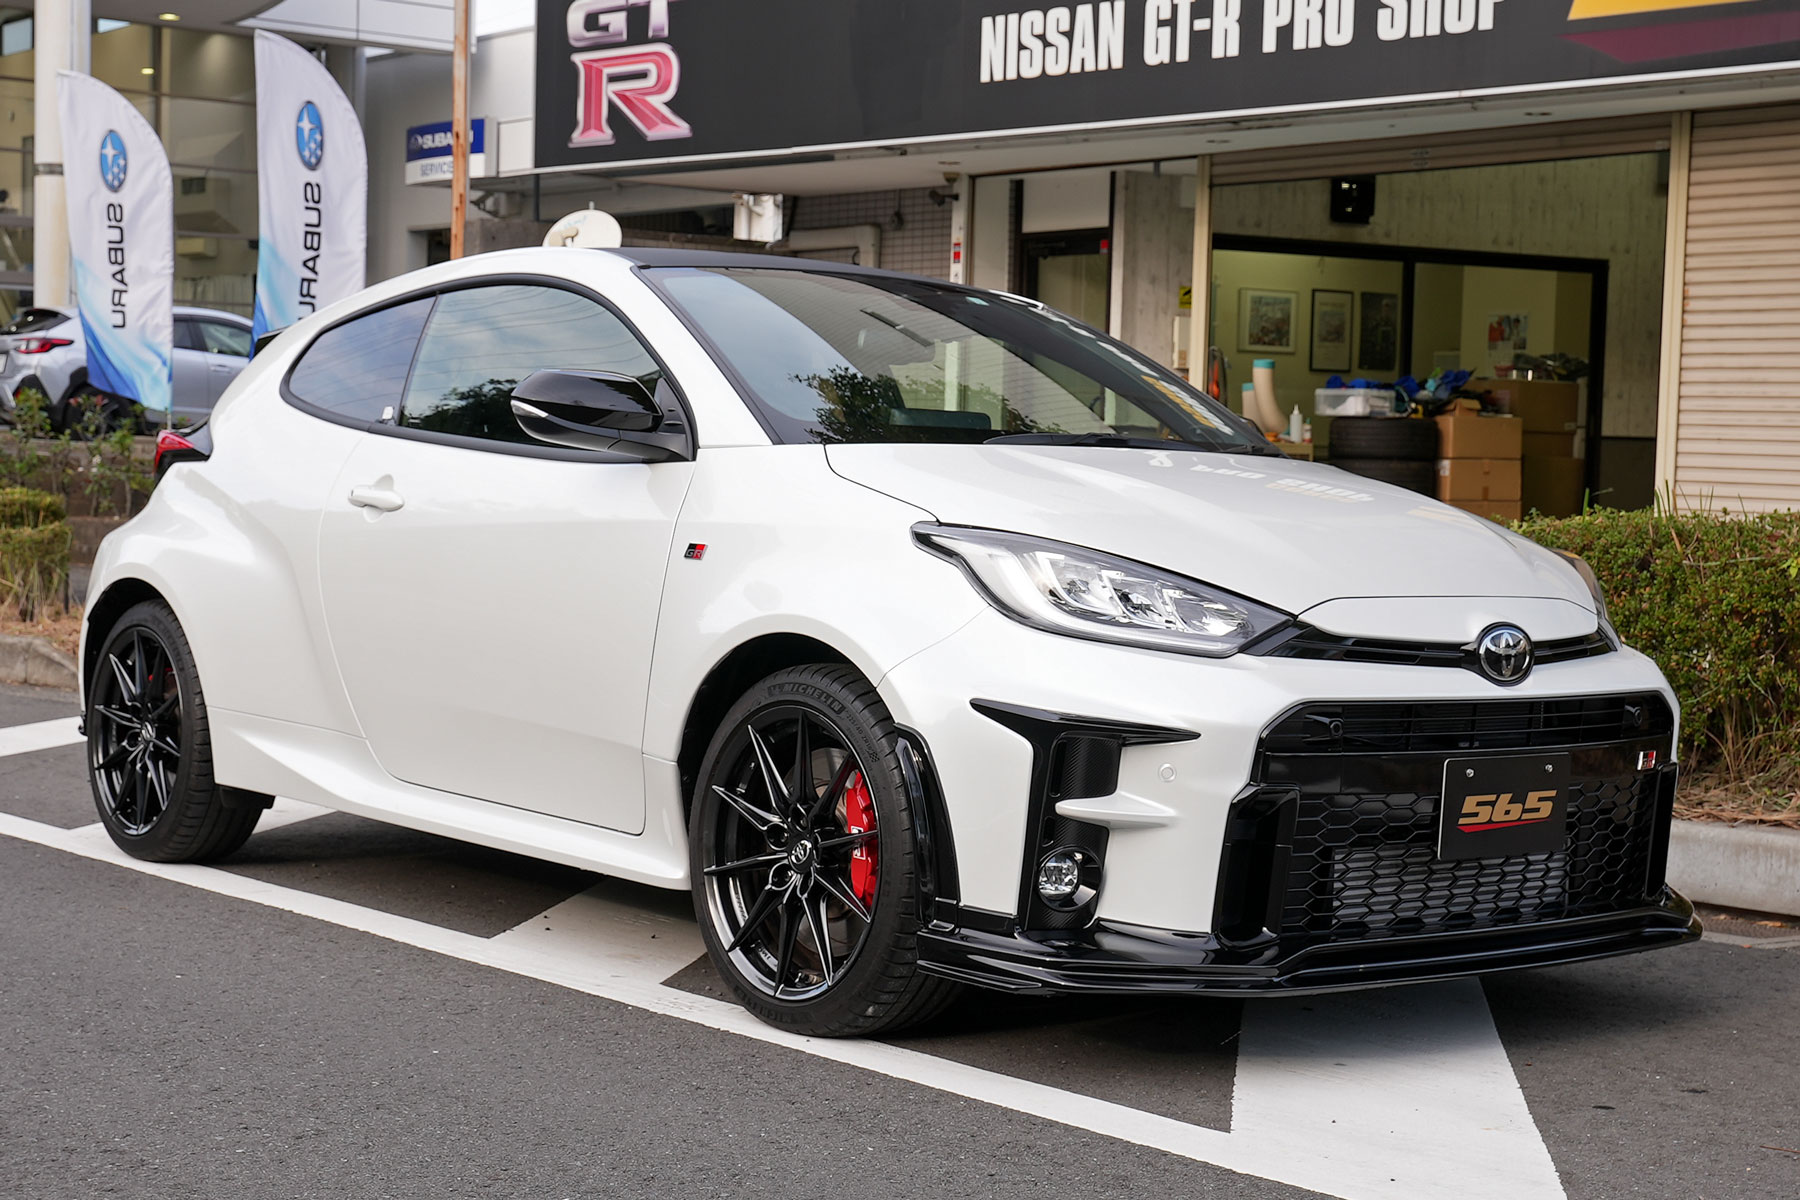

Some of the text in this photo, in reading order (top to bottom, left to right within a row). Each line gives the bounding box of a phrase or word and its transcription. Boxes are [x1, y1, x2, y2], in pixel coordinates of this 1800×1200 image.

[567, 0, 669, 48] GT
[980, 0, 1125, 83] NISSAN
[1143, 0, 1241, 66] GT-R
[1262, 0, 1354, 54] PRO
[568, 42, 692, 148] R
[422, 130, 474, 150] SUBA
[783, 683, 843, 712] MICHELIN
[1458, 790, 1557, 825] 565
